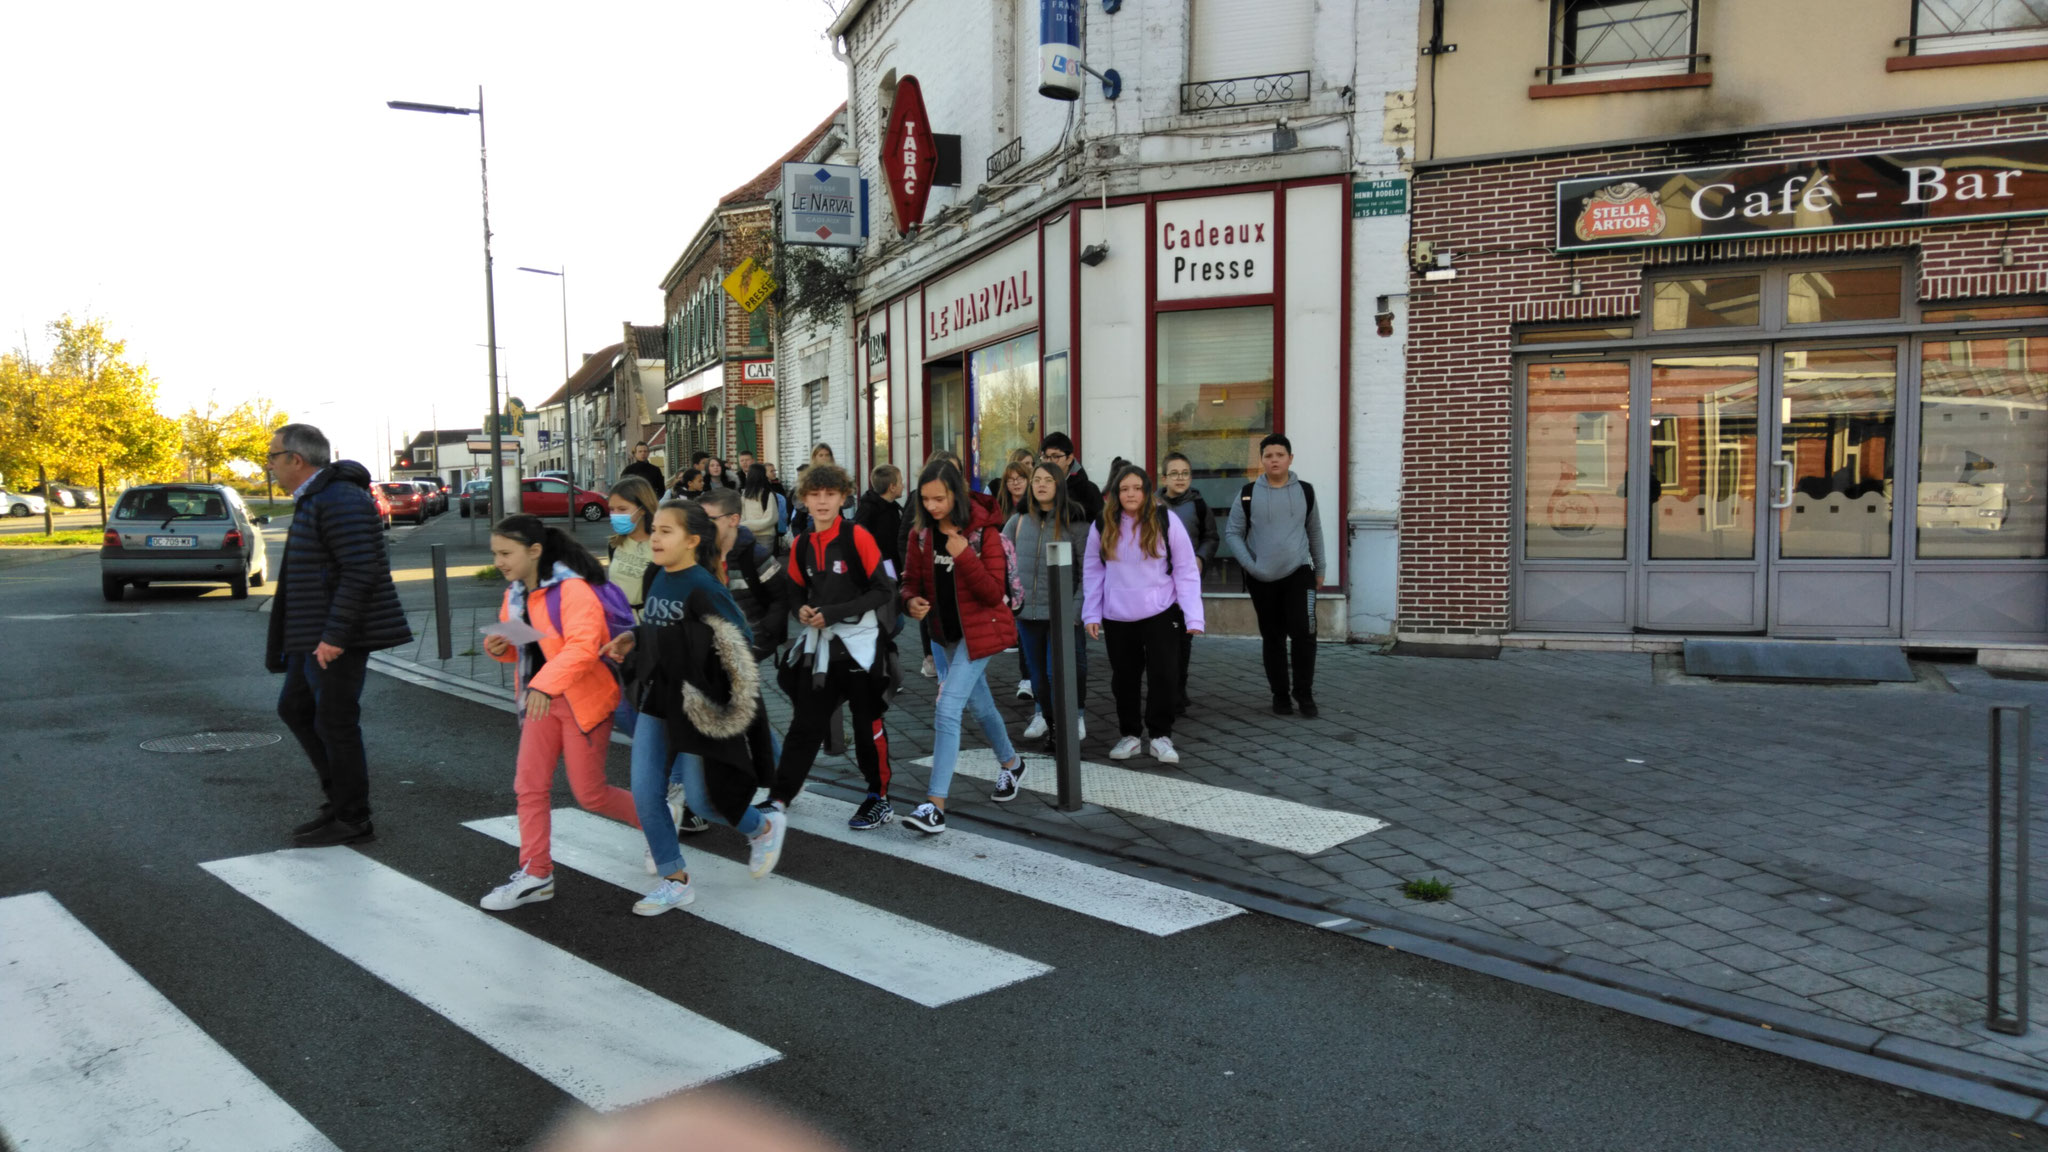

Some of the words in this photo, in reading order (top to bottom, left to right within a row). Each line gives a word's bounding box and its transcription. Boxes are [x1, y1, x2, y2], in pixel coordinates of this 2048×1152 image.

[903, 121, 917, 195] TABAC
[792, 192, 807, 210] LE
[810, 193, 855, 213] NARVAL
[1354, 191, 1373, 199] HENRI
[1690, 174, 1833, 222] Café
[1900, 164, 2023, 206] Bar
[1592, 216, 1650, 231] ARTOIS
[1593, 204, 1649, 219] STELLA
[1163, 219, 1265, 250] Cadeaux
[1174, 256, 1254, 283] Presse
[745, 279, 773, 309] PRESSE
[930, 306, 949, 341] LE
[952, 270, 1032, 331] NARVAL
